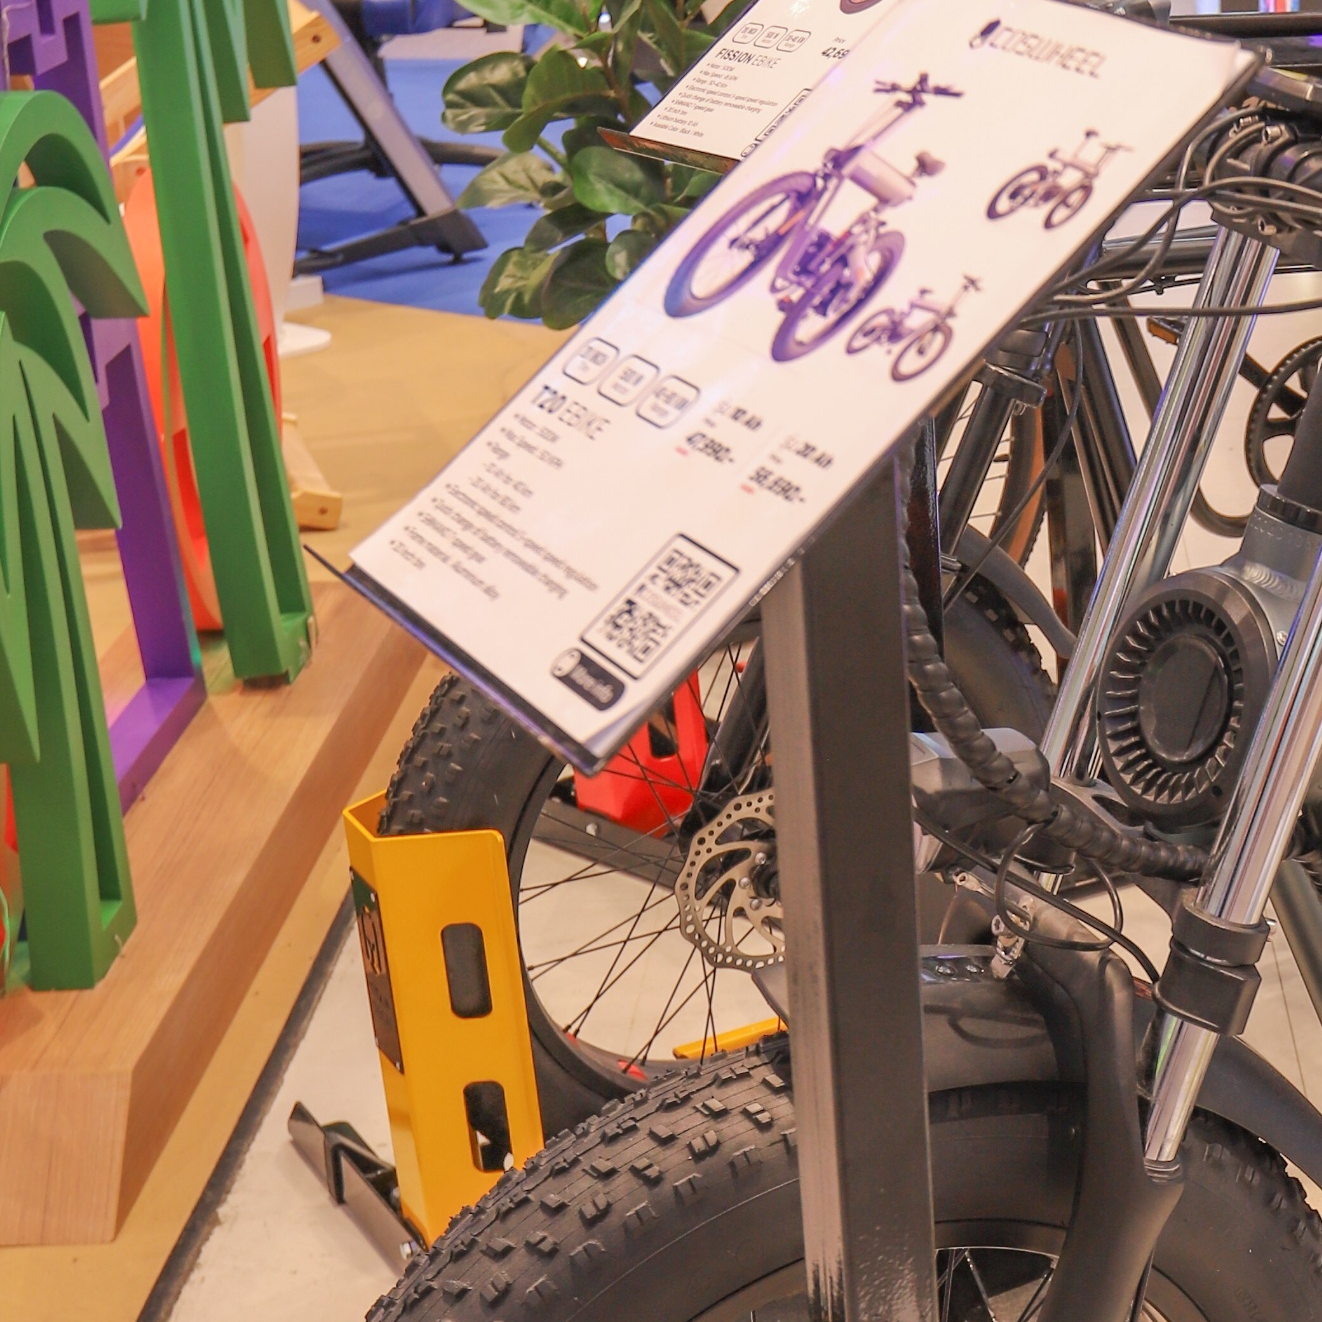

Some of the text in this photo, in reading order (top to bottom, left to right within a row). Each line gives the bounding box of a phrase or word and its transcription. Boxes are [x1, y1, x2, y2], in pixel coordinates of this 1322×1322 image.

[711, 48, 783, 68] FISSION EBIKE
[983, 24, 1117, 79] COSWHEEL
[528, 382, 612, 443] T20 EBIKE
